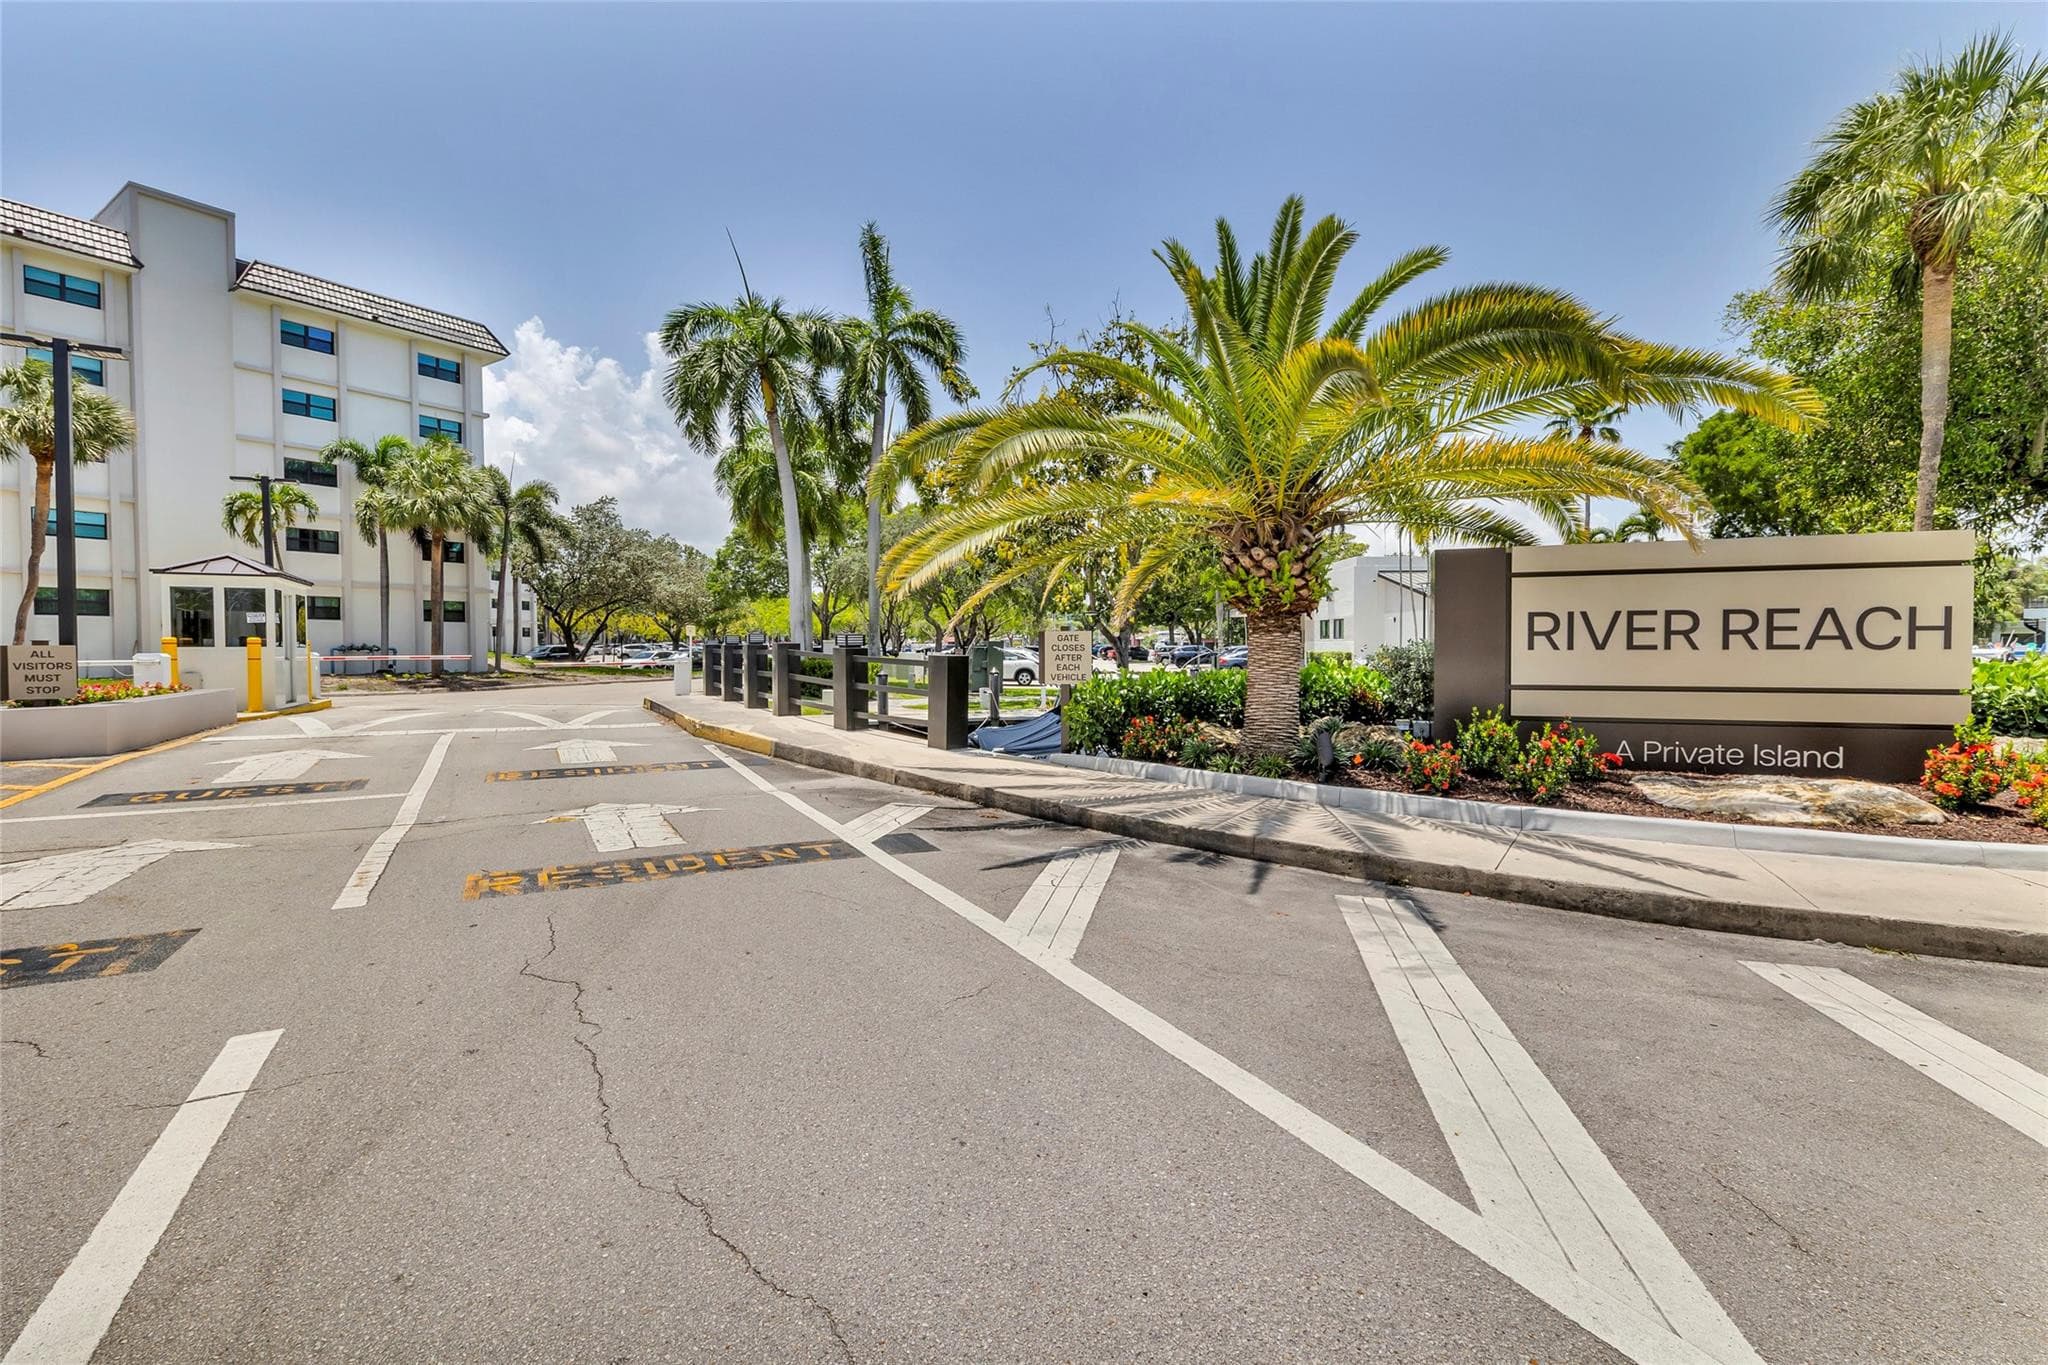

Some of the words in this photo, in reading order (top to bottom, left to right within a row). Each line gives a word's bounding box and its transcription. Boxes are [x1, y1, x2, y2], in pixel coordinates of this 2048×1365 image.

[1527, 610, 1700, 651] RIVER
[1722, 605, 1953, 651] REACH
[1057, 634, 1079, 642] GATE
[1051, 644, 1085, 652] CLOSES
[30, 650, 55, 658] ALL
[12, 662, 73, 671] VISITORS
[24, 674, 61, 682] MUST
[1051, 673, 1087, 681] VEHICLE
[26, 686, 61, 695] STOP
[1615, 739, 1634, 762] A
[1643, 740, 1745, 766] Private
[1753, 743, 1844, 769] Island
[129, 782, 336, 803] GUEST
[466, 844, 832, 899] RESIDENT
